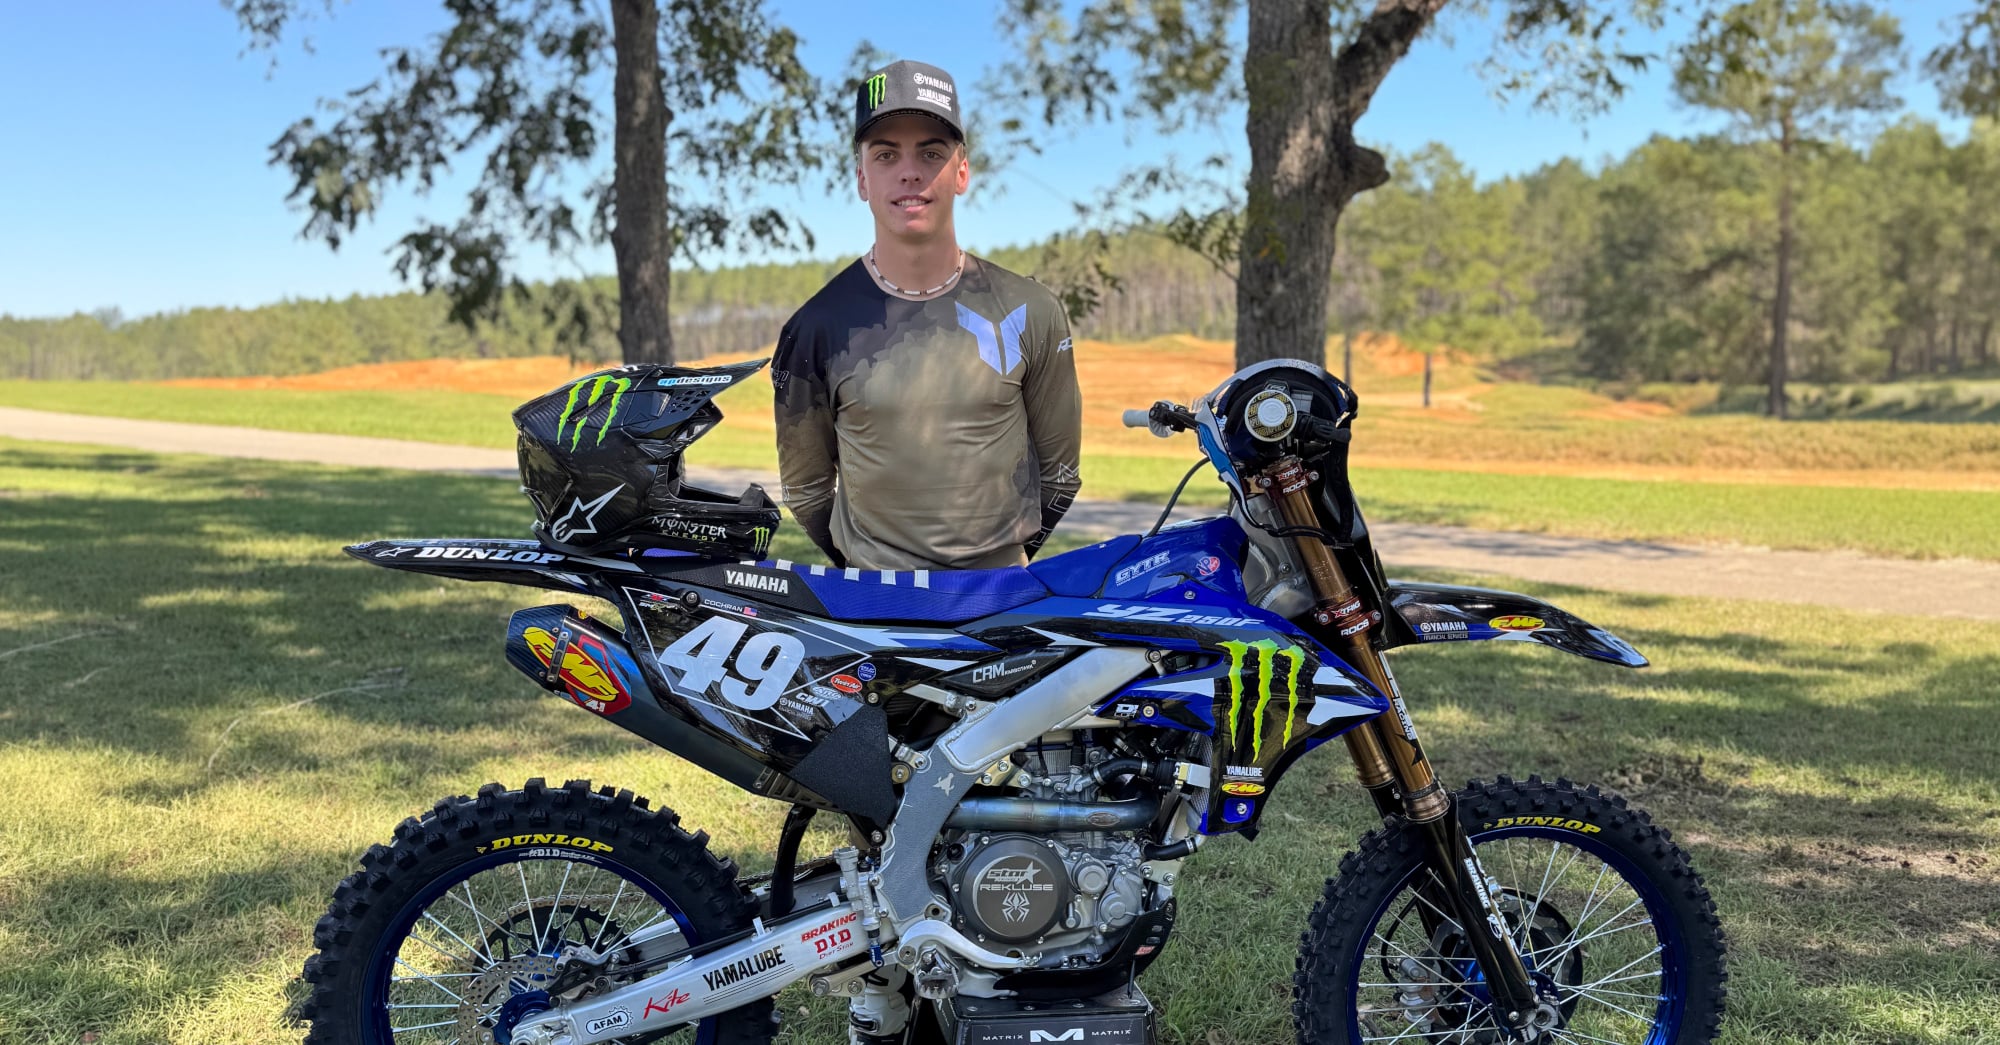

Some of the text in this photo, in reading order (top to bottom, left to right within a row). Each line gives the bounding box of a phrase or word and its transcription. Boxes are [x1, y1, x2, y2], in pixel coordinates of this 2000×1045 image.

[923, 75, 953, 94] YAMAHA
[917, 87, 952, 107] YAMALUBE
[1282, 479, 1306, 494] ROCS
[651, 516, 727, 539] MONSTER
[661, 529, 717, 542] ENERGY
[414, 547, 566, 564] DUNLOP
[1115, 550, 1171, 587] GYTR
[725, 570, 789, 594] YAMAHA
[704, 598, 743, 613] COCHRAN
[1082, 603, 1265, 627] YZ 250F
[1331, 600, 1361, 619] XTRIG
[1340, 618, 1370, 637] ROCS
[1430, 621, 1468, 632] YAMAHA
[1489, 617, 1544, 630] FMF
[657, 615, 806, 711] 49
[972, 662, 1005, 684] CRM
[786, 699, 815, 715] YAMAHA
[1226, 765, 1263, 777] YAMALUBE
[1222, 783, 1266, 793] FMF
[1493, 816, 1602, 834] DUNLOP
[491, 833, 614, 853] DUNLOP
[979, 883, 1054, 891] REKLUSE
[1463, 857, 1492, 909] BRAKING
[801, 912, 857, 943] BRAKING
[702, 946, 786, 992] YAMALUBE
[643, 988, 690, 1020] Kite
[593, 1015, 623, 1031] AFAM
